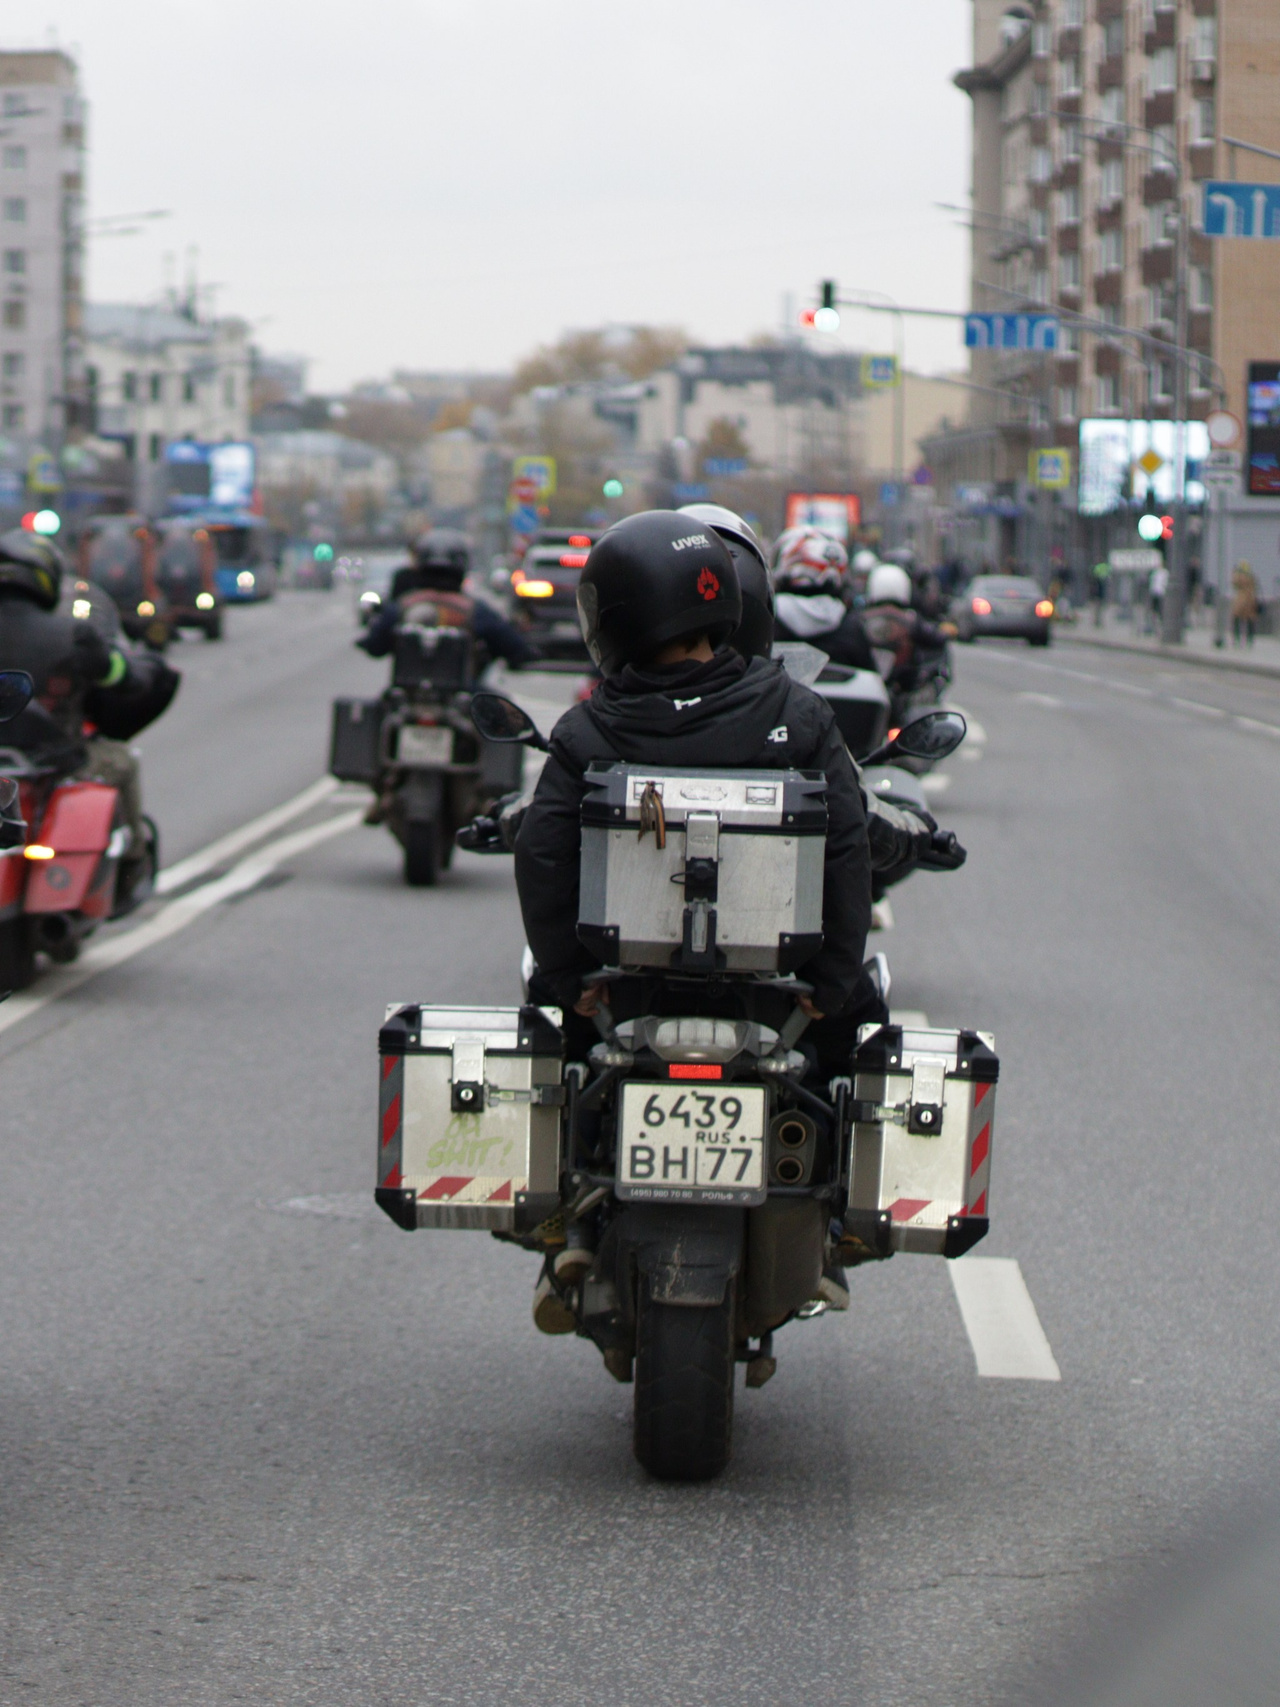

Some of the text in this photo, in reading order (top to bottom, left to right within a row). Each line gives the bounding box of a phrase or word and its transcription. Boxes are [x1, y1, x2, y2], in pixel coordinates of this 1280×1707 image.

[671, 534, 709, 551] uvex
[643, 1093, 743, 1130] 6439
[695, 1131, 732, 1145] RUS
[705, 1147, 753, 1182] 77
[630, 1188, 652, 1198] (495)
[702, 1191, 734, 1200] РОЛЬФ
